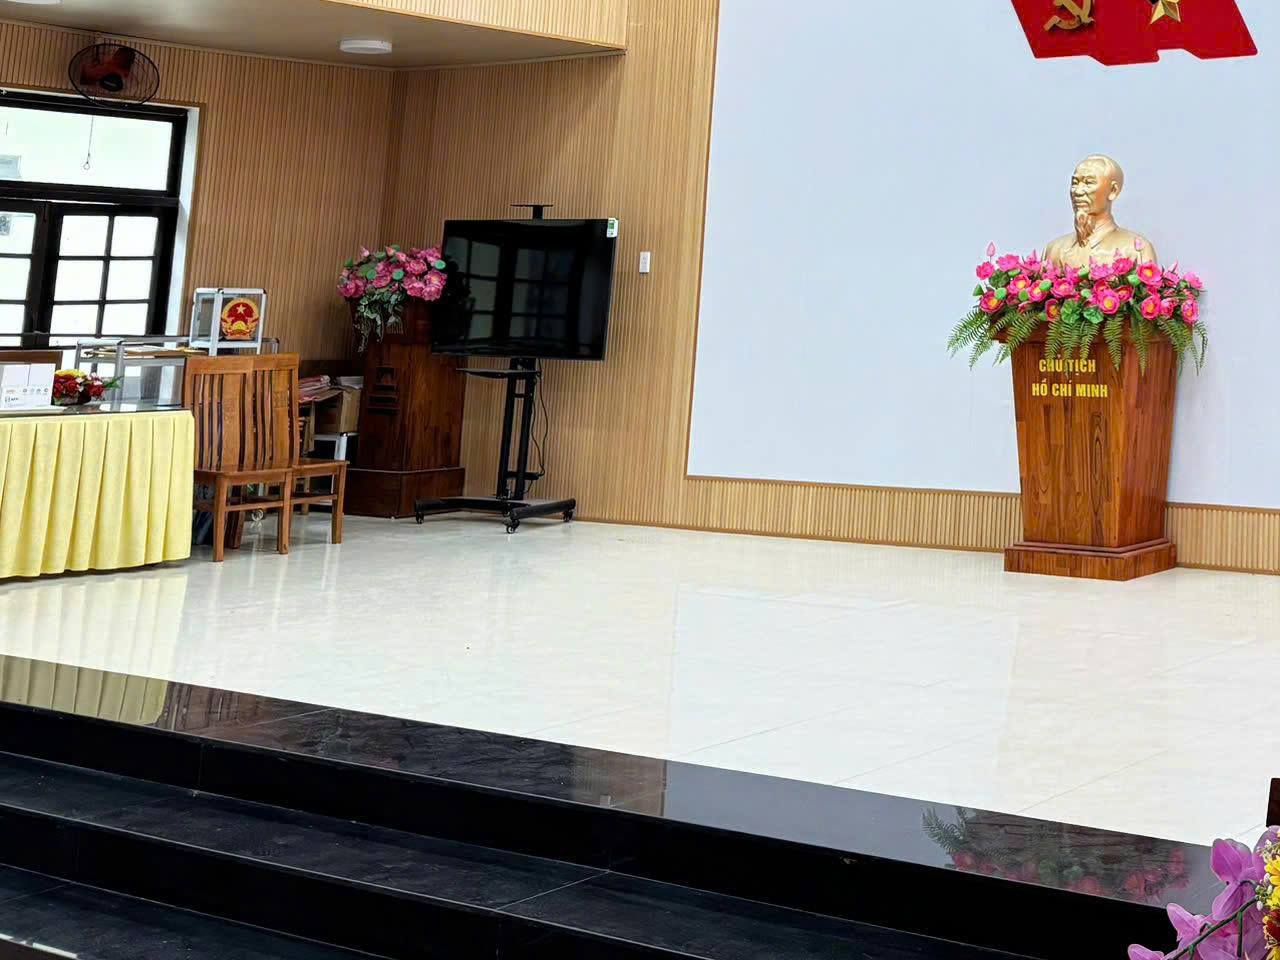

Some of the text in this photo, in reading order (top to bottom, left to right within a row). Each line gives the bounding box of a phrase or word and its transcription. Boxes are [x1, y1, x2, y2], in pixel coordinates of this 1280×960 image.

[1068, 358, 1097, 376] TỊCH
[1051, 380, 1072, 397] CHÍ
[1075, 383, 1108, 398] MINH
